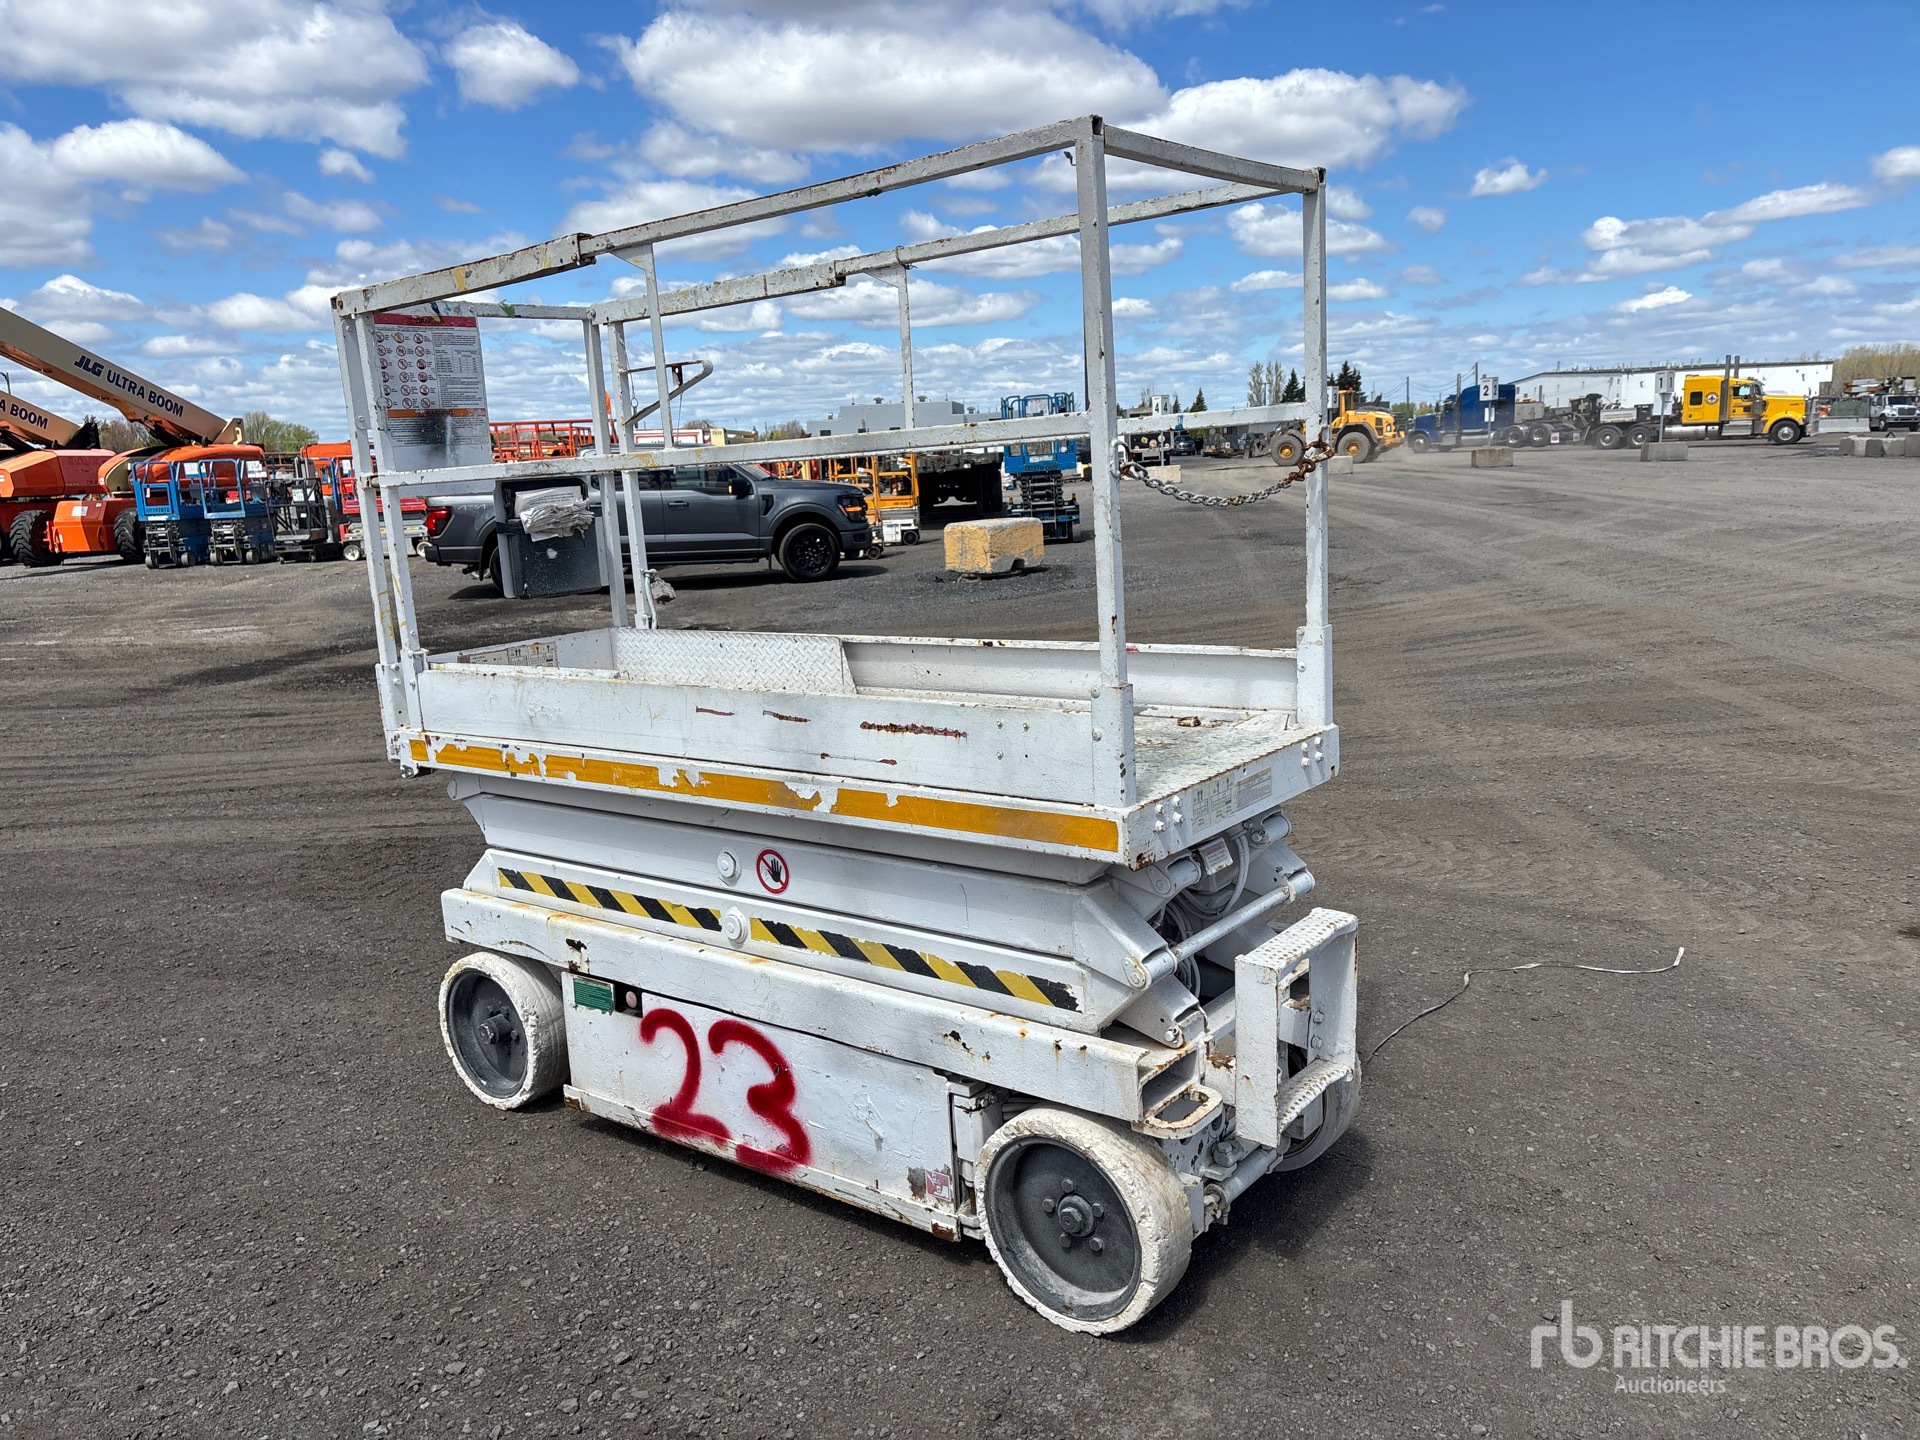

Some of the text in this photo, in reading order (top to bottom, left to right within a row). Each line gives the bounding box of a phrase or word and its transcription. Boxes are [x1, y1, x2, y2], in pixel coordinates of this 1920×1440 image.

[74, 355, 184, 418] JLG ULTRA BOOM
[1483, 385, 1489, 396] 2
[1493, 385, 1497, 396] 2
[1154, 402, 1160, 413] 4
[1163, 401, 1168, 413] 4
[9, 403, 49, 430] BOOM
[639, 1007, 812, 1173] 23
